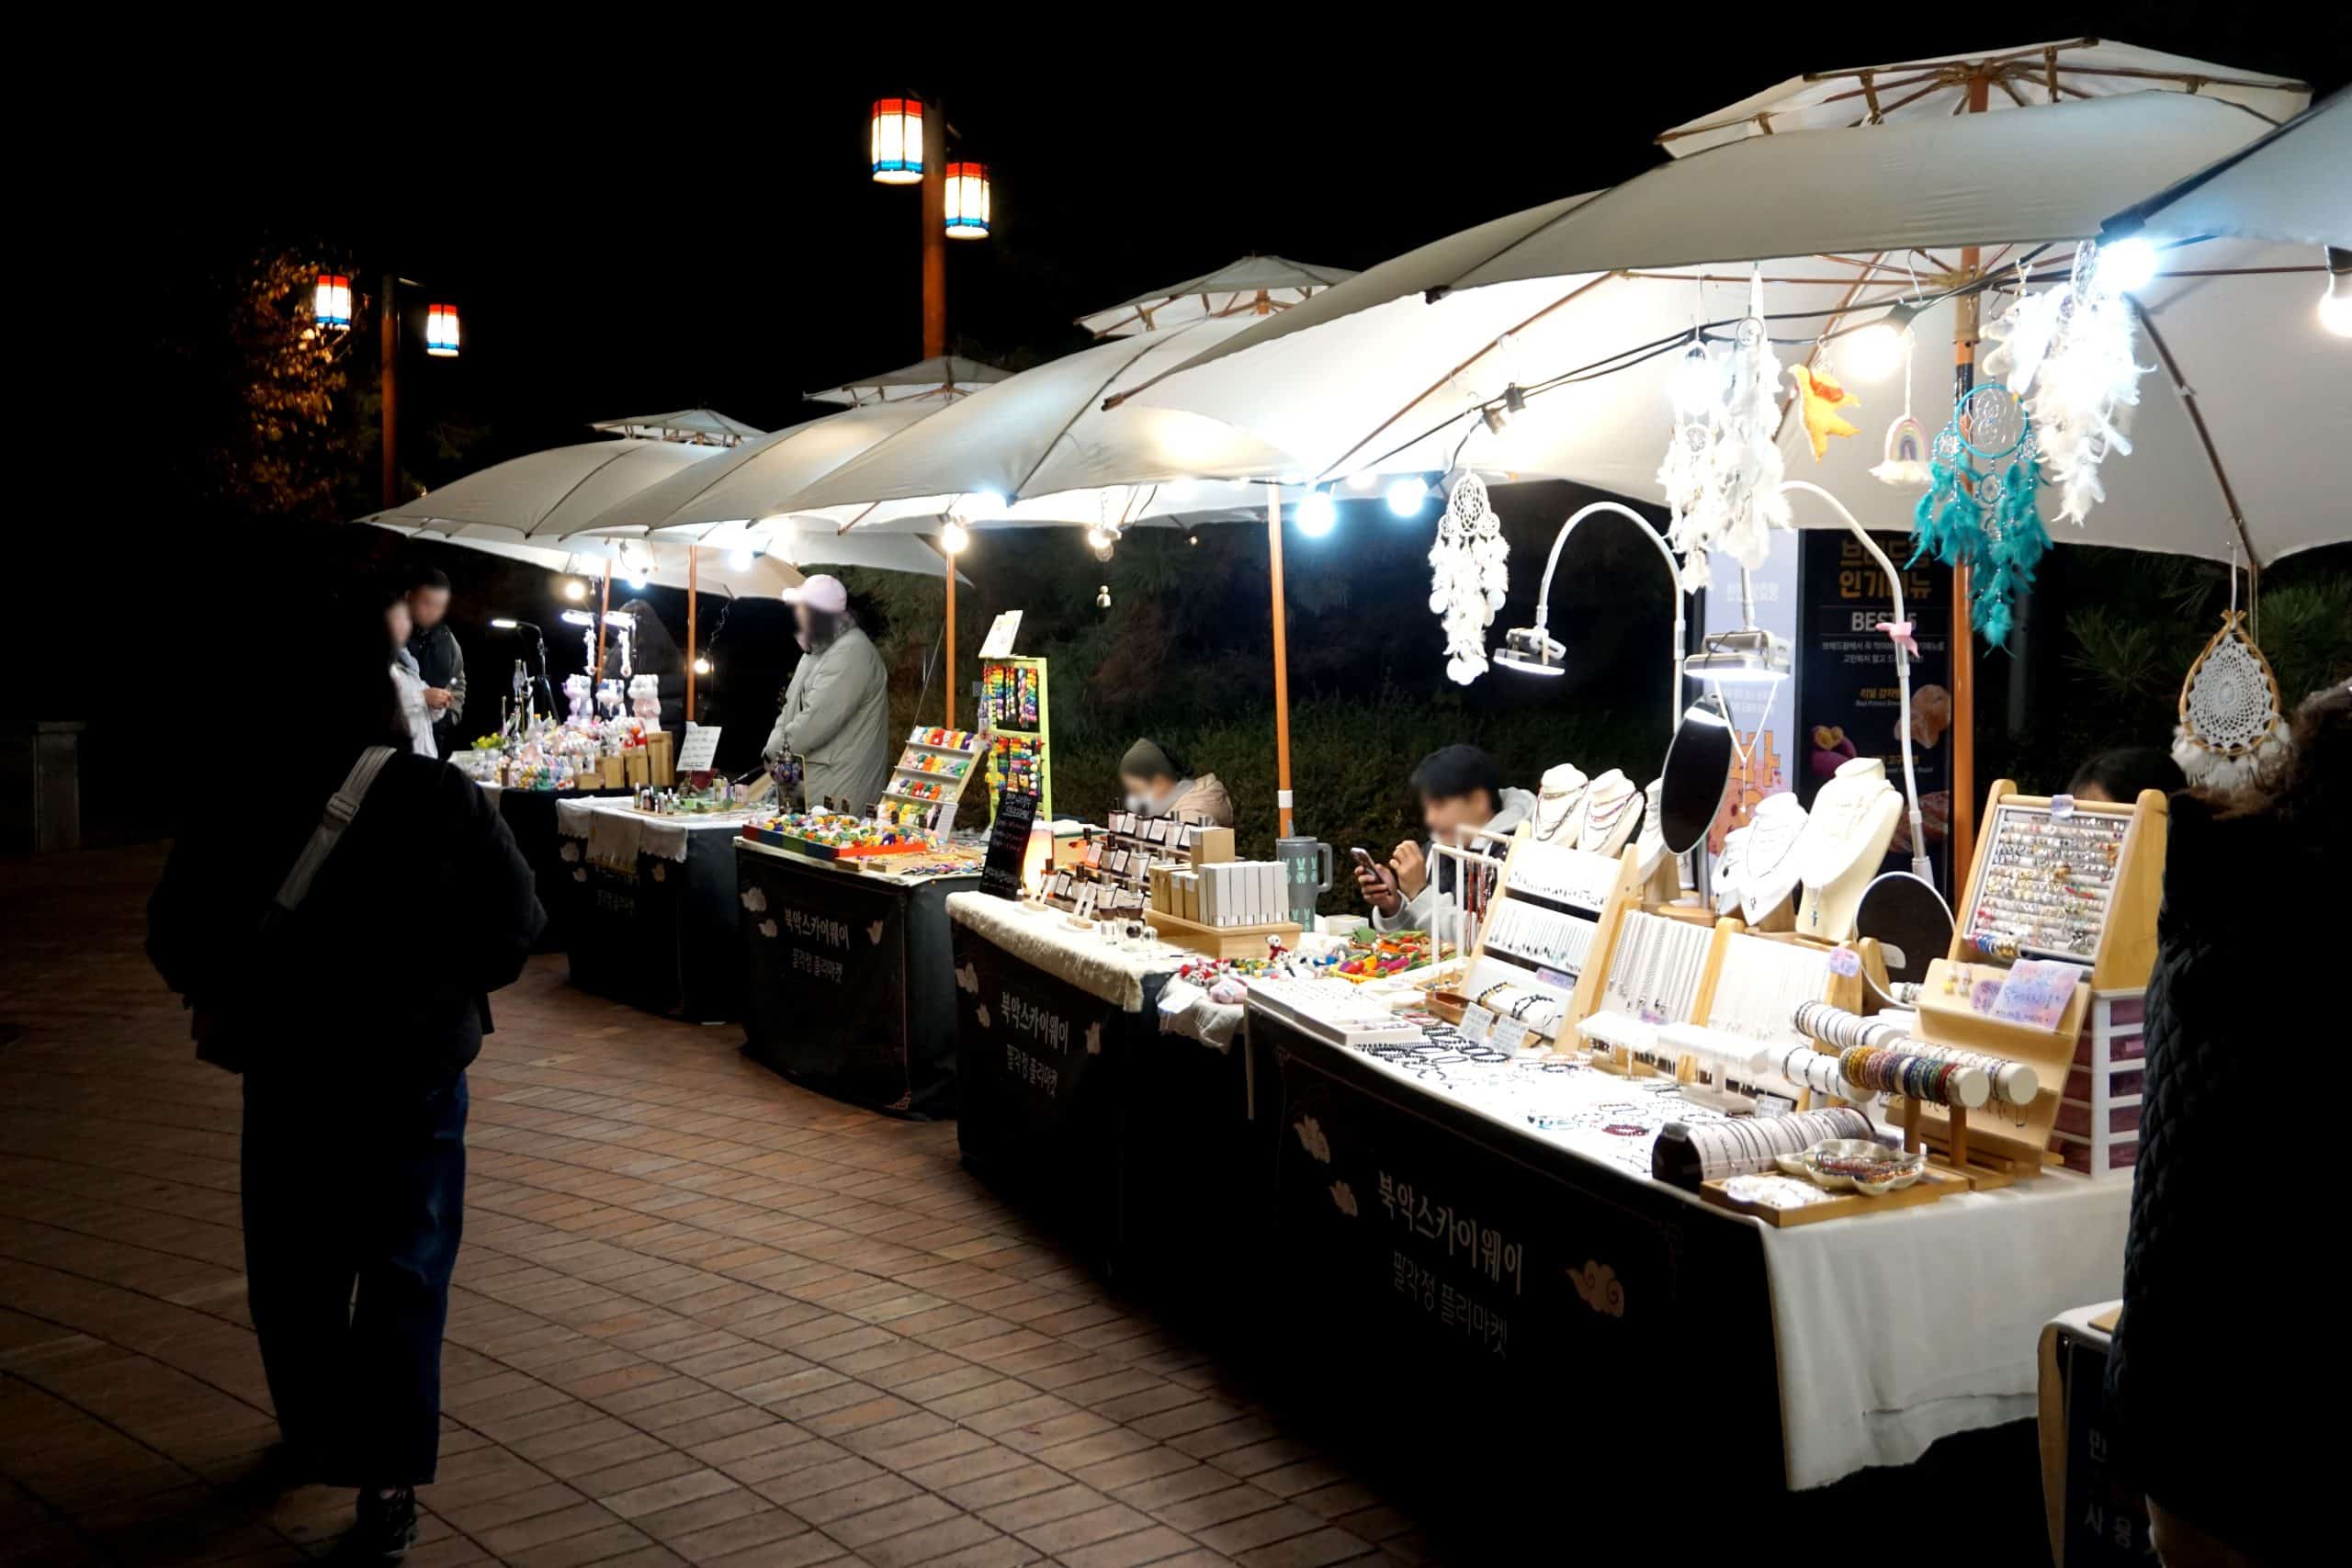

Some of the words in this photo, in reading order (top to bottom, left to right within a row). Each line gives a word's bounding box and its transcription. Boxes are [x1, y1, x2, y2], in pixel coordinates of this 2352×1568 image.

[785, 907, 850, 951] 북악스카이웨이
[1001, 992, 1069, 1055] 북악스카이웨이
[1379, 1169, 1524, 1296] 북악스카이웨이
[1392, 1249, 1435, 1314] 팔각정
[1441, 1283, 1508, 1360] 플리마켓
